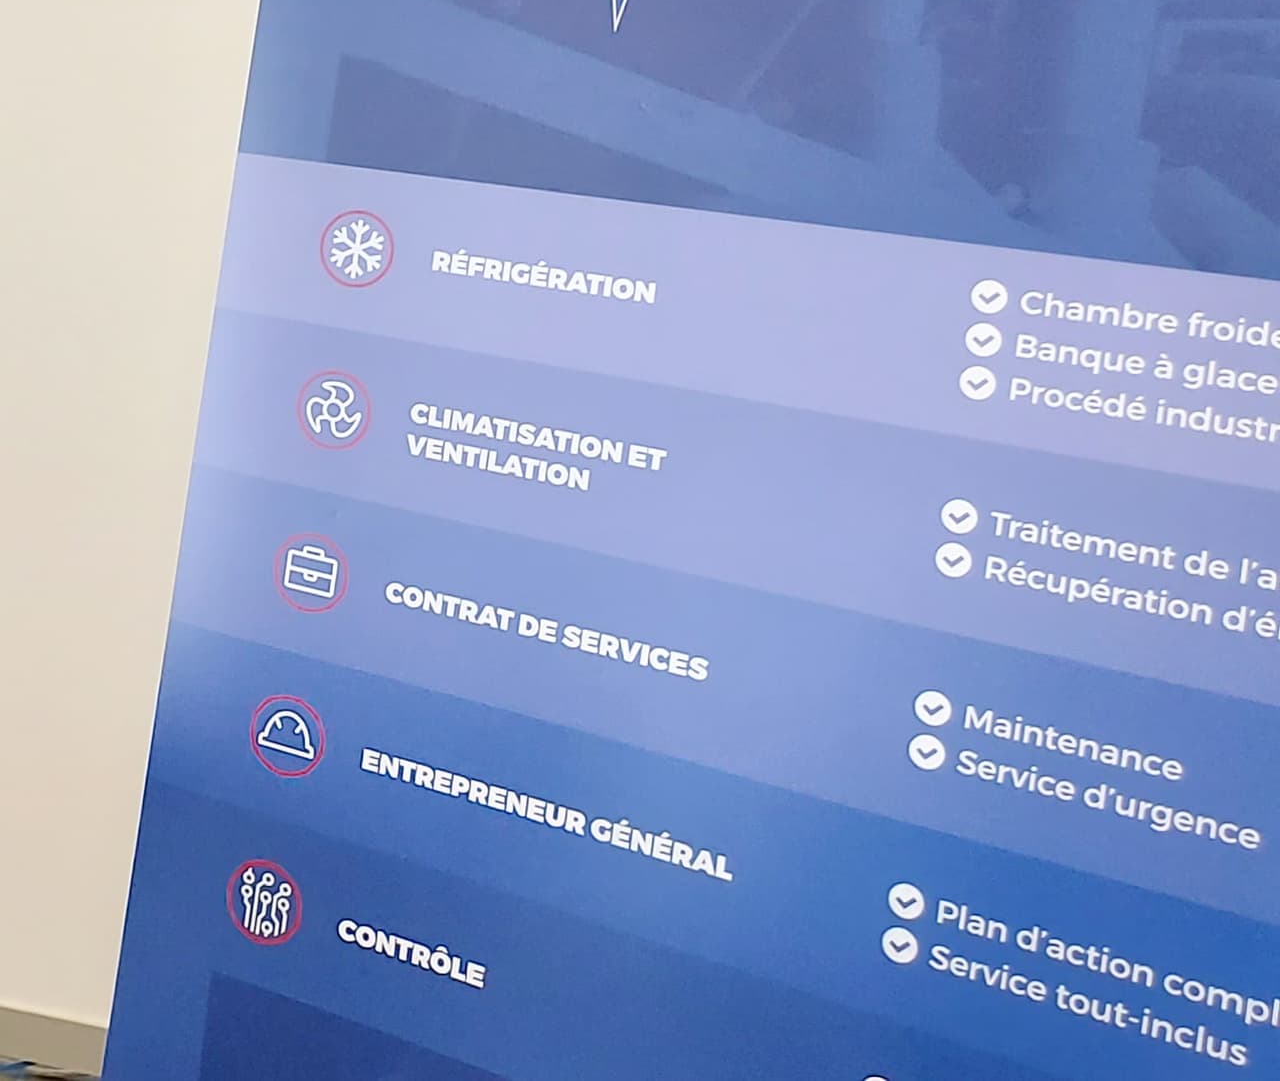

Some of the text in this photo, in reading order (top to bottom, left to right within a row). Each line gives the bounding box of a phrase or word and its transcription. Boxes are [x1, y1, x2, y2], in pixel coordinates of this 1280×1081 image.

[430, 248, 658, 305] RÉFRIGÉRATION
[1019, 290, 1179, 334] Chambre
[1008, 377, 1147, 422] Procédé
[1015, 334, 1280, 396] Banque à glace
[406, 433, 591, 492] VENTILATION
[409, 402, 668, 472] CLIMATISATION ET
[990, 510, 1176, 571] Traitement
[1183, 550, 1230, 580] de
[384, 581, 710, 681] CONTRAT DE SERVICES
[983, 555, 1280, 639] Récupération d'é
[962, 705, 1184, 781] Maintenance
[361, 748, 734, 882] ENTREPRENEUR GÉNÉRAL
[956, 750, 1261, 850] Service d'urgence
[337, 919, 486, 989] CONTRÔLE
[936, 899, 1280, 1027] Plan d'action compl
[928, 946, 1249, 1067] Service tout-inclus
